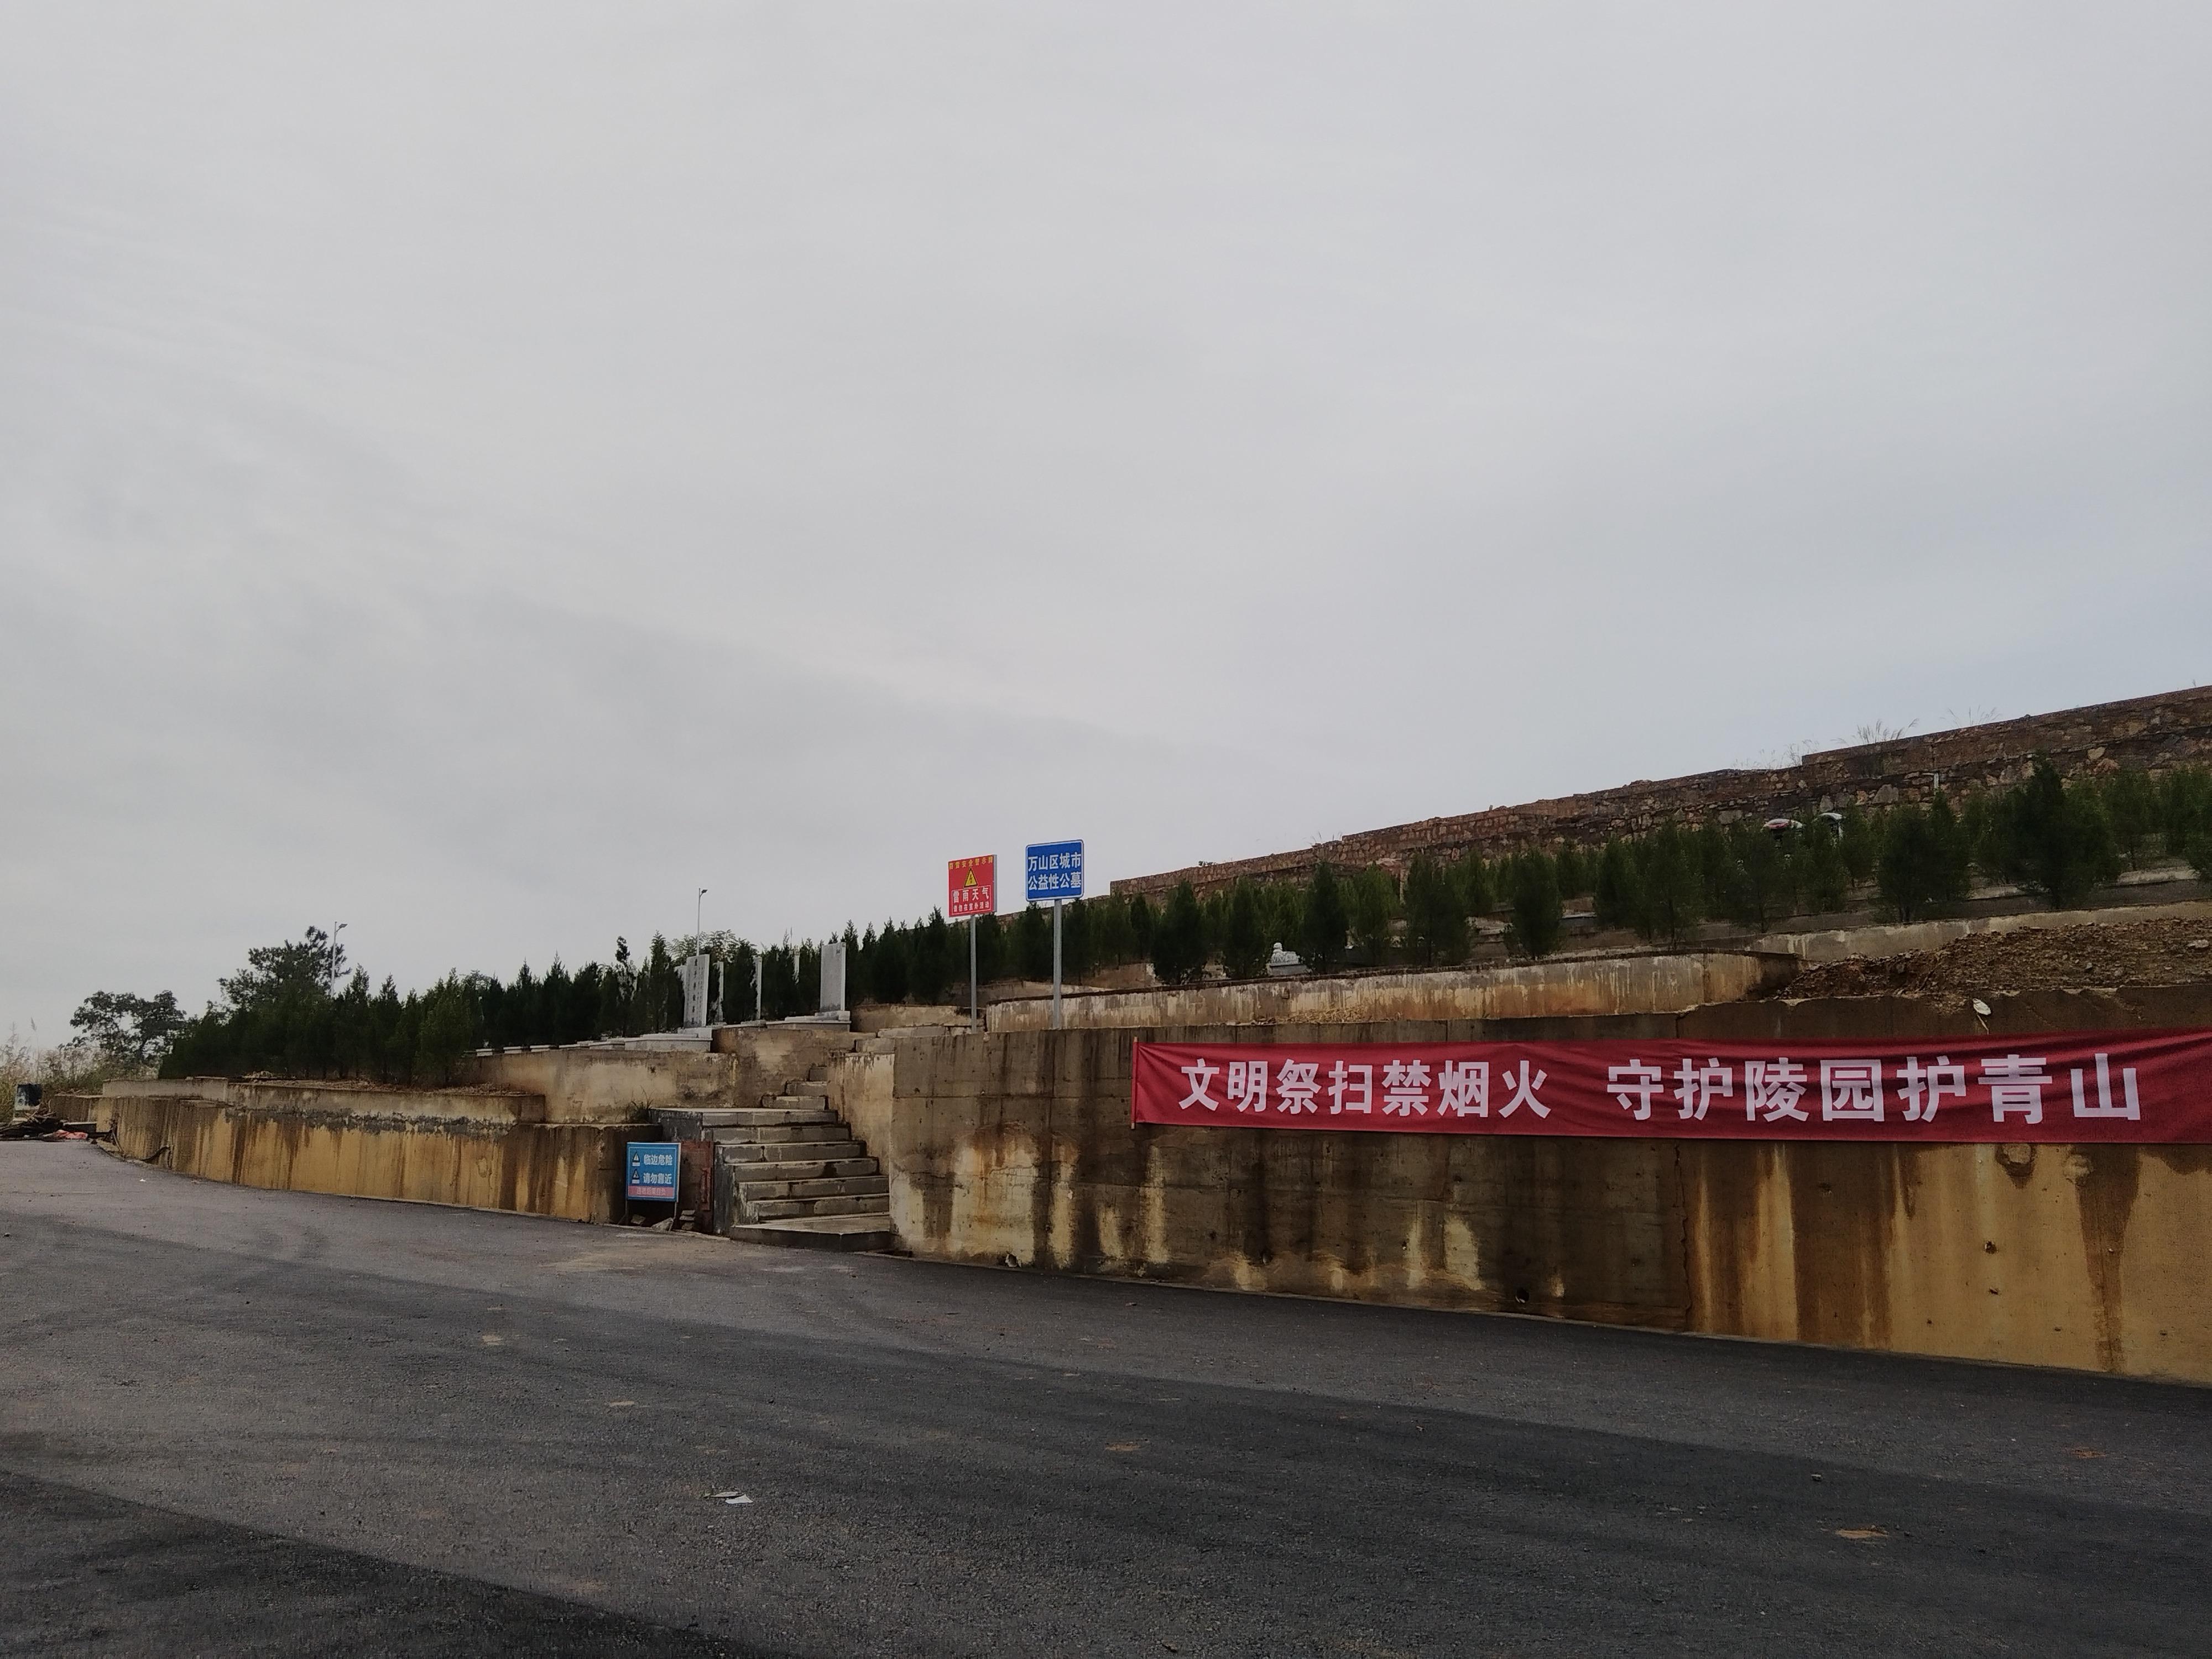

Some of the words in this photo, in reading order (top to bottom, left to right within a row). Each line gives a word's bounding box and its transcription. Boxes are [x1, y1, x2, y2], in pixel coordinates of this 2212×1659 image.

[1028, 852, 1081, 871] 万山区城市
[1028, 872, 1081, 890] 公益性公墓
[953, 886, 989, 903] 雷雨天气
[1178, 1058, 1551, 1119] 文明祭扫禁烟火
[1607, 1053, 2141, 1124] 守护陵园护青山
[644, 1154, 673, 1166] 临边危险
[643, 1172, 672, 1185] 请勿靠近
